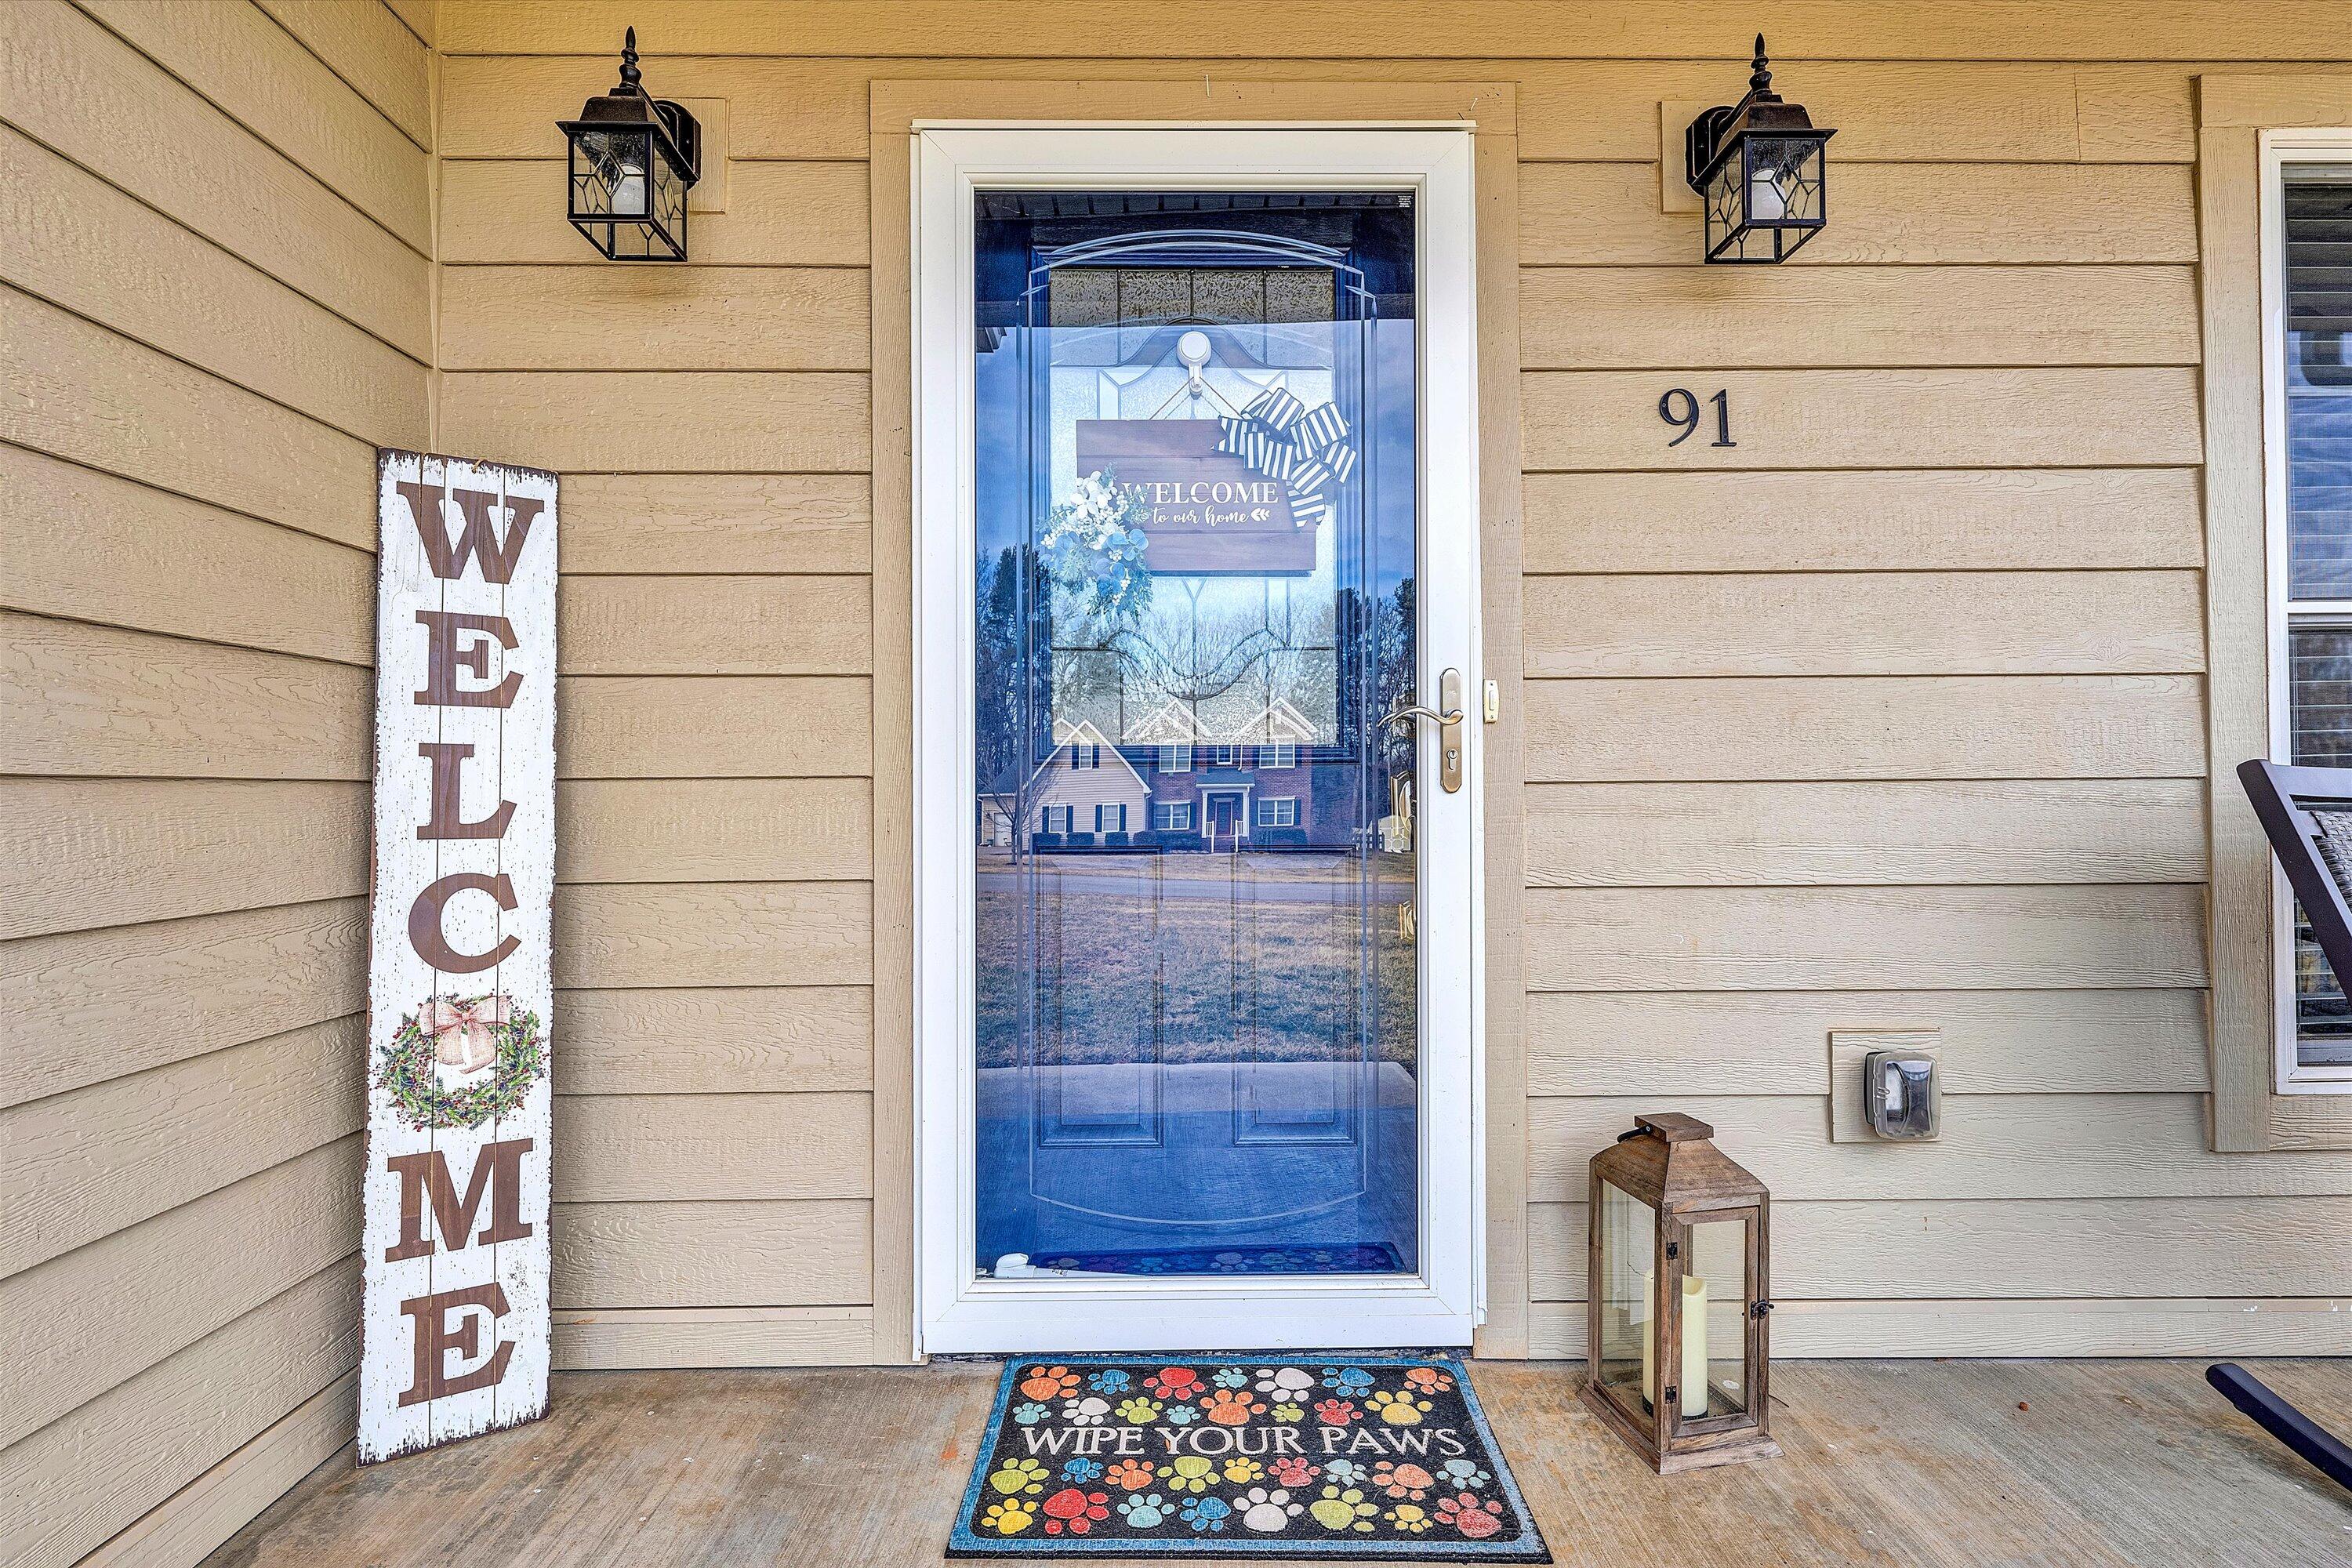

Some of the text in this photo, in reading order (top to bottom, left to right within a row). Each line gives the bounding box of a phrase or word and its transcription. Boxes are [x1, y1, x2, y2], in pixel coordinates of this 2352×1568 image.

[1658, 387, 1737, 447] 91
[1151, 504, 1250, 527] to our home
[1020, 1426, 1468, 1457] WIPE YOUR PAWS
